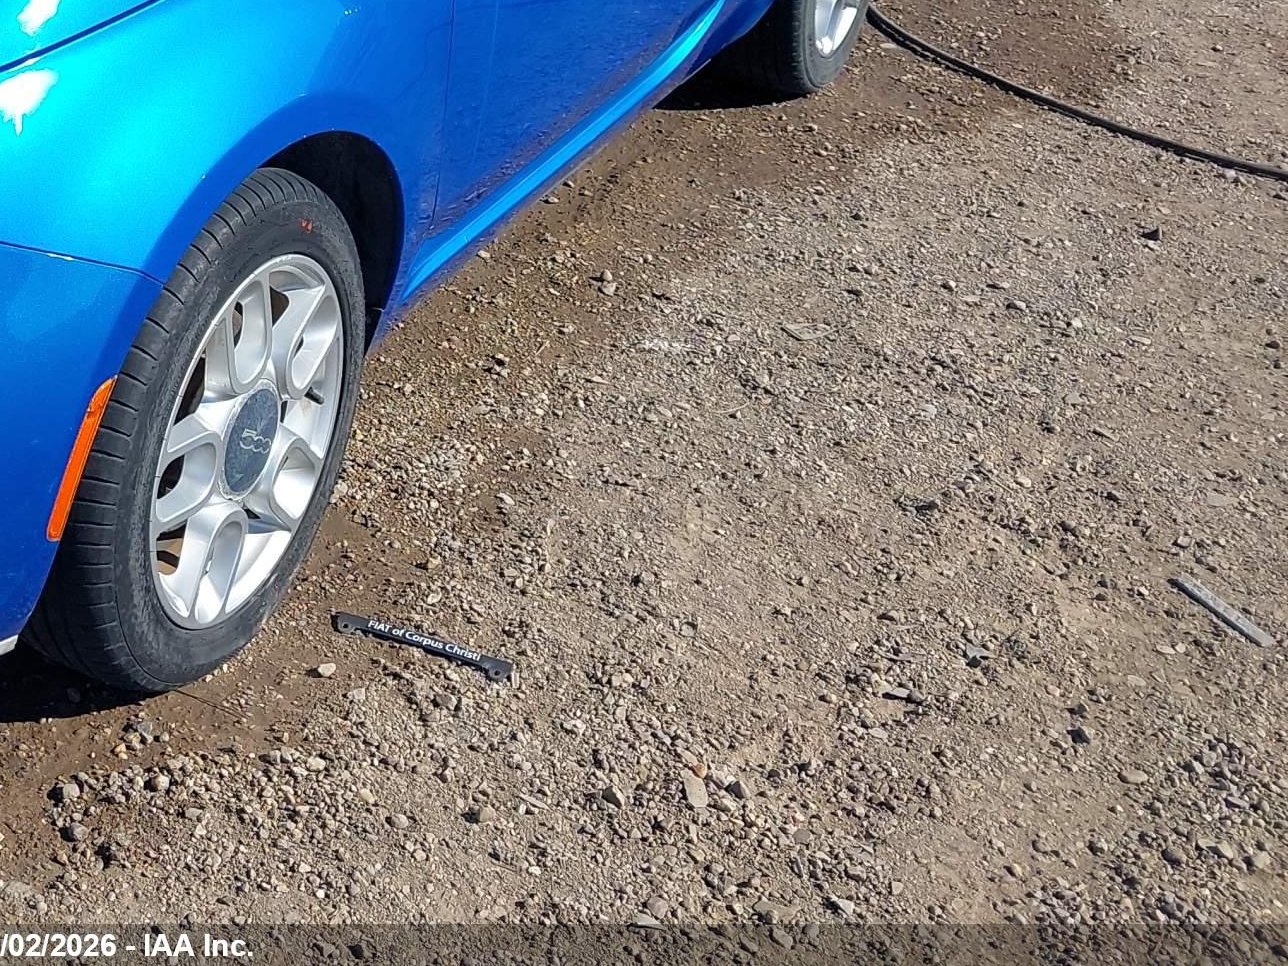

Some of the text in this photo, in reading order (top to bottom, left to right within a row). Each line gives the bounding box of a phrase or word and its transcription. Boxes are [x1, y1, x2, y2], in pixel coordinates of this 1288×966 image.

[367, 620, 481, 662] FIAT of Corpus Christi
